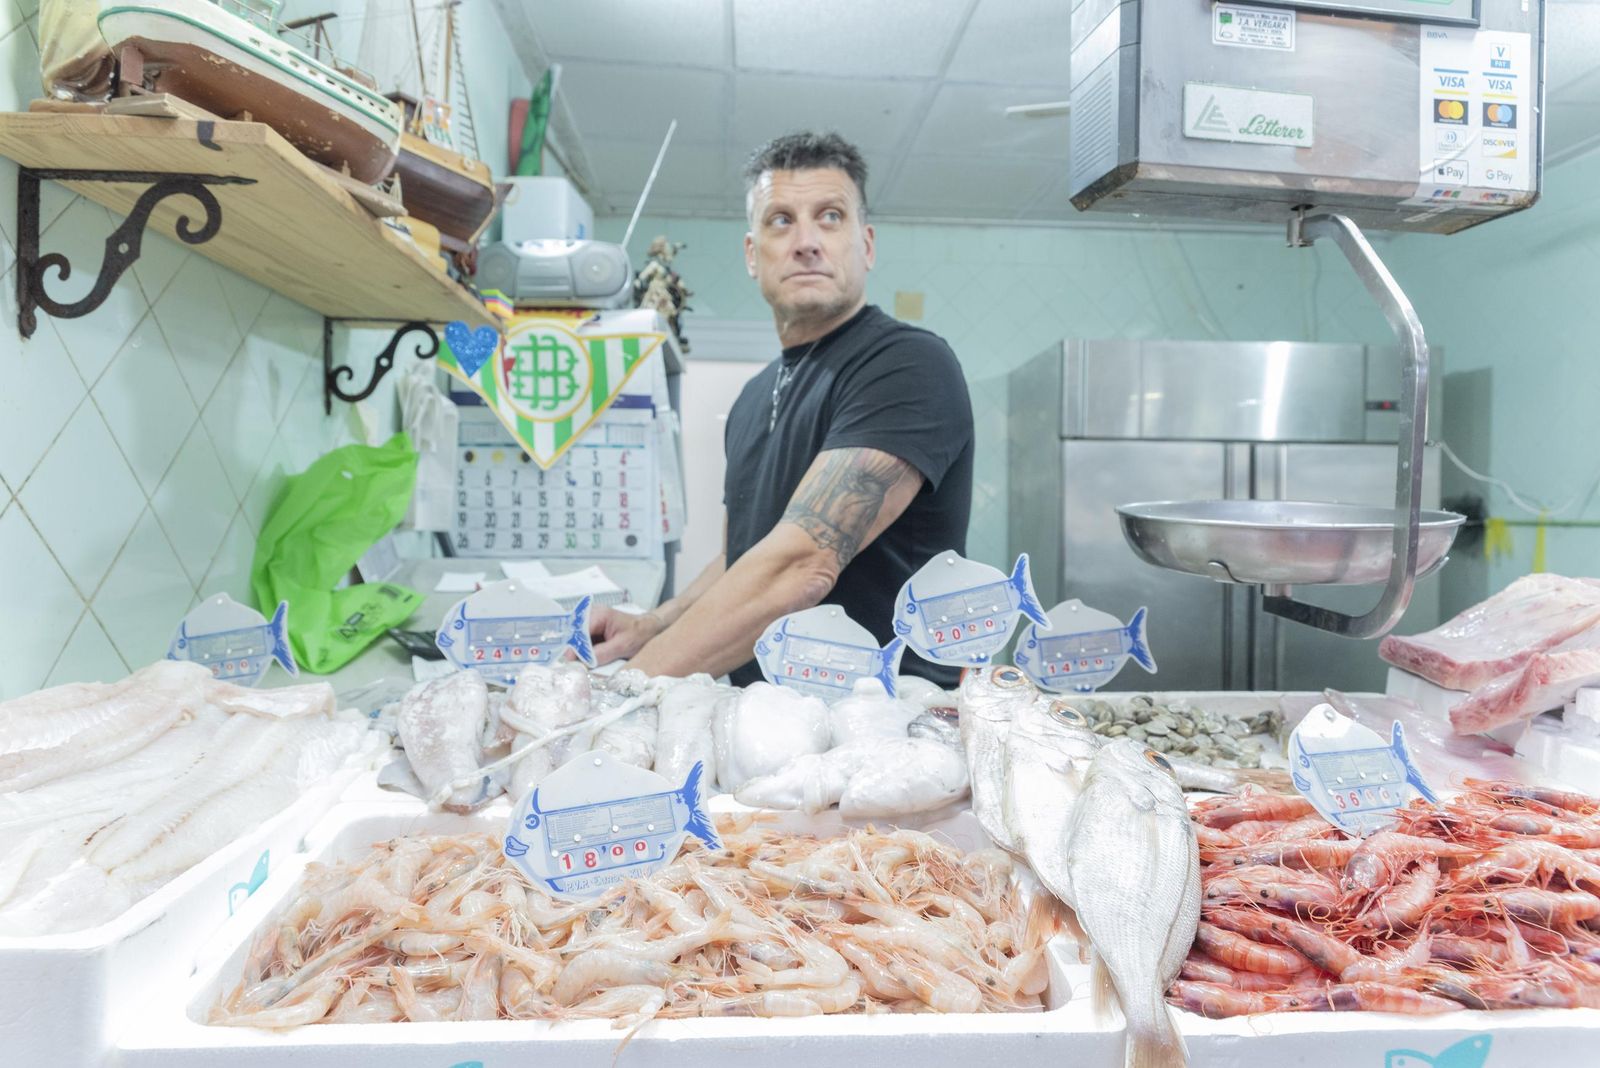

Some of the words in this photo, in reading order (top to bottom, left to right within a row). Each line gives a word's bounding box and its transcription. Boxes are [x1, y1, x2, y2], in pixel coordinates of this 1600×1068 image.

[1254, 20, 1287, 30] VERGARA
[1427, 31, 1448, 39] BBVA
[1439, 76, 1465, 88] VISA
[1488, 79, 1512, 90] VISA
[1239, 114, 1304, 139] Letterer
[1483, 138, 1515, 147] DISCOVER
[1446, 166, 1464, 180] Pay
[1497, 170, 1513, 184] Pay
[592, 470, 601, 487] 10
[511, 491, 522, 507] 14
[538, 491, 547, 507] 15
[565, 491, 574, 507] 16
[592, 491, 601, 507] 17
[619, 491, 628, 507] 18
[485, 512, 496, 528] 20
[538, 512, 549, 528] 22
[592, 512, 604, 528] 24
[619, 512, 630, 528] 25
[458, 532, 468, 549] 26
[485, 532, 496, 549] 27
[511, 532, 522, 549] 28
[538, 532, 549, 549] 29
[565, 532, 576, 549] 30
[592, 532, 601, 549] 31
